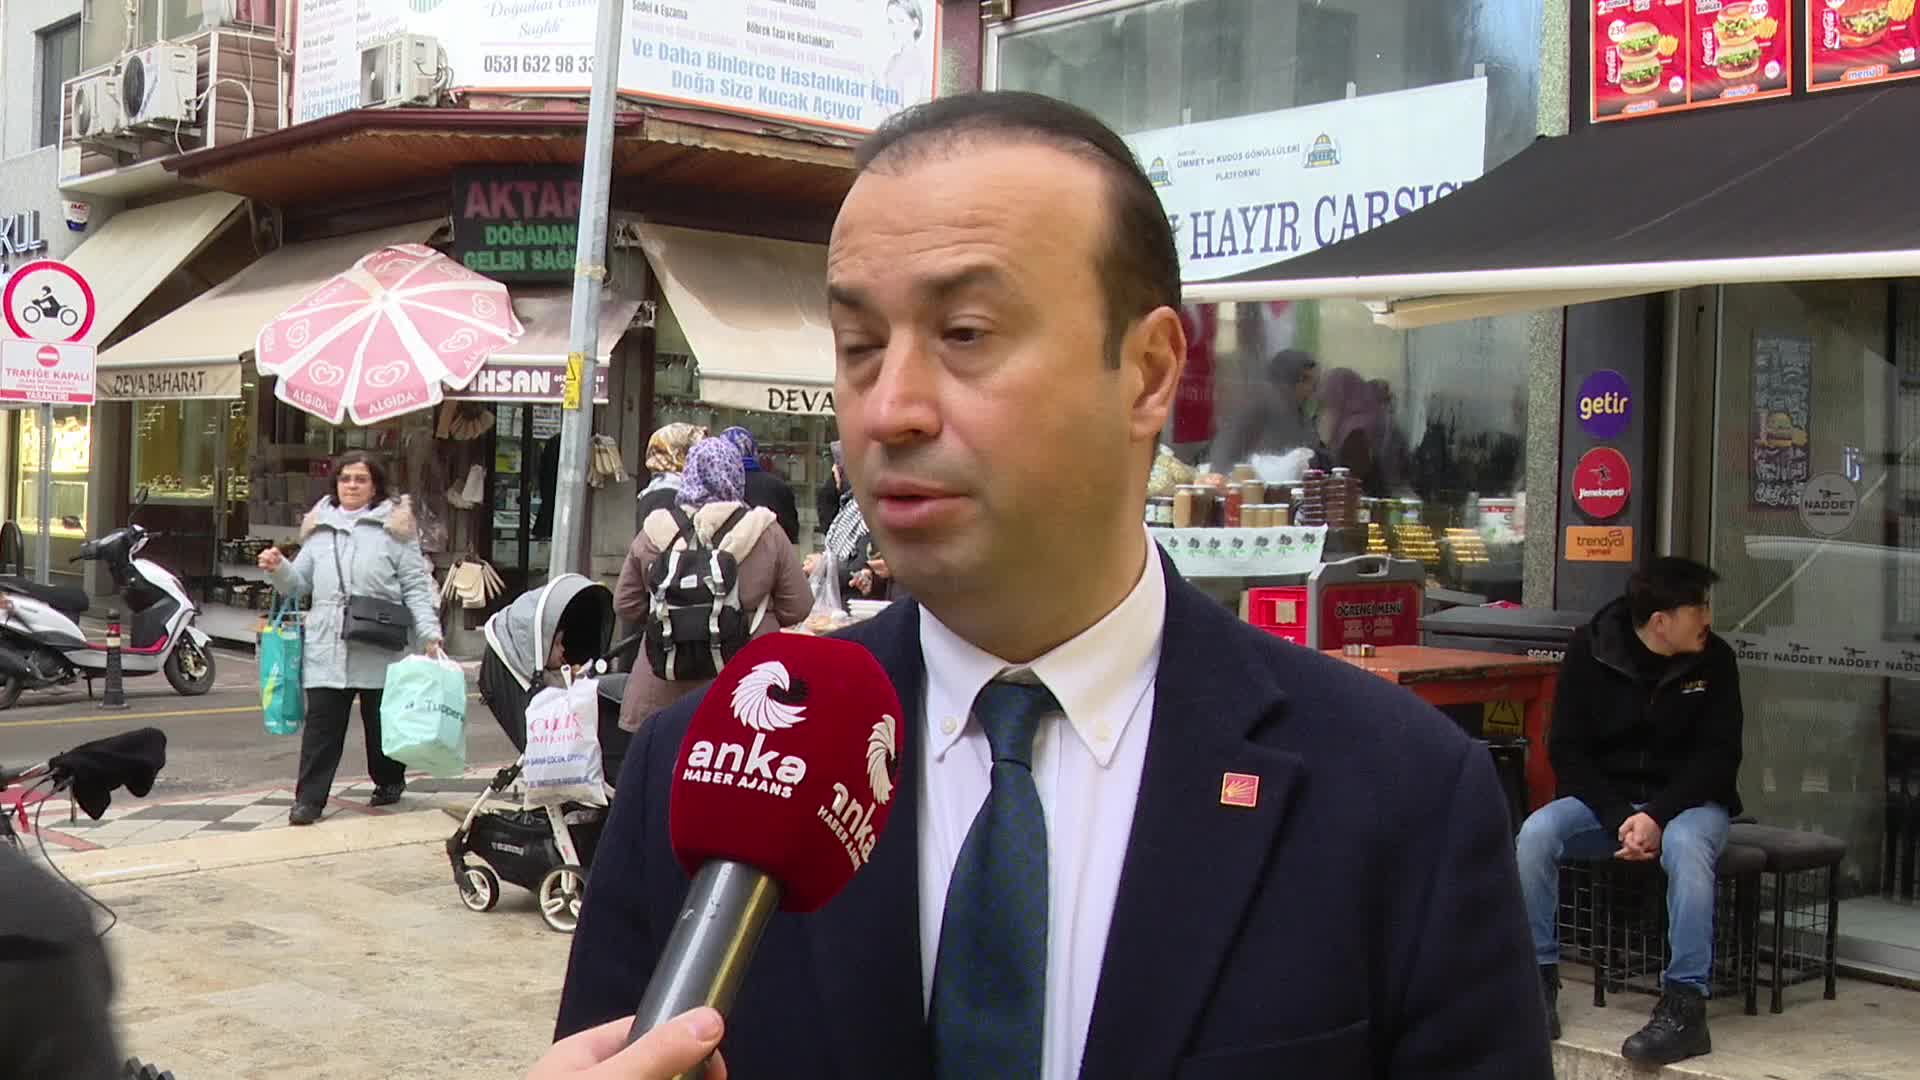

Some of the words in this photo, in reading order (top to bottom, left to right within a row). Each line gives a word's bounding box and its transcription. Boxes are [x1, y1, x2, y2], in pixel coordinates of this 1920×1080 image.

[483, 55, 518, 73] 0531
[522, 55, 551, 73] 632
[555, 55, 574, 73] 98
[632, 37, 653, 57] Ve
[659, 42, 701, 67] Daha
[706, 51, 777, 81] Binlerce
[781, 66, 865, 98] Hastalıklar
[672, 69, 715, 93] Doğa
[719, 79, 753, 100] Size
[758, 84, 808, 112] Kucak
[813, 95, 864, 121] Açıyor
[1190, 200, 1302, 261] HAYIR
[464, 251, 526, 271] GELEN
[5, 367, 50, 378] TRAFİĞE
[53, 370, 89, 382] KAPALI
[148, 370, 206, 393] BAHARAT
[292, 388, 329, 414] ALGIDA
[368, 391, 412, 415] ALGIDA
[768, 387, 836, 412] DEVA
[1580, 391, 1628, 420] getir
[1804, 500, 1856, 510] NADDET
[1577, 534, 1624, 549] trendyol
[1774, 654, 1823, 665] NADDET
[1828, 657, 1880, 669] NADDET
[688, 732, 806, 785] anka
[682, 768, 734, 785] HABER
[737, 775, 793, 799] AJANS
[817, 805, 848, 844] HABER
[832, 782, 876, 863] anka
